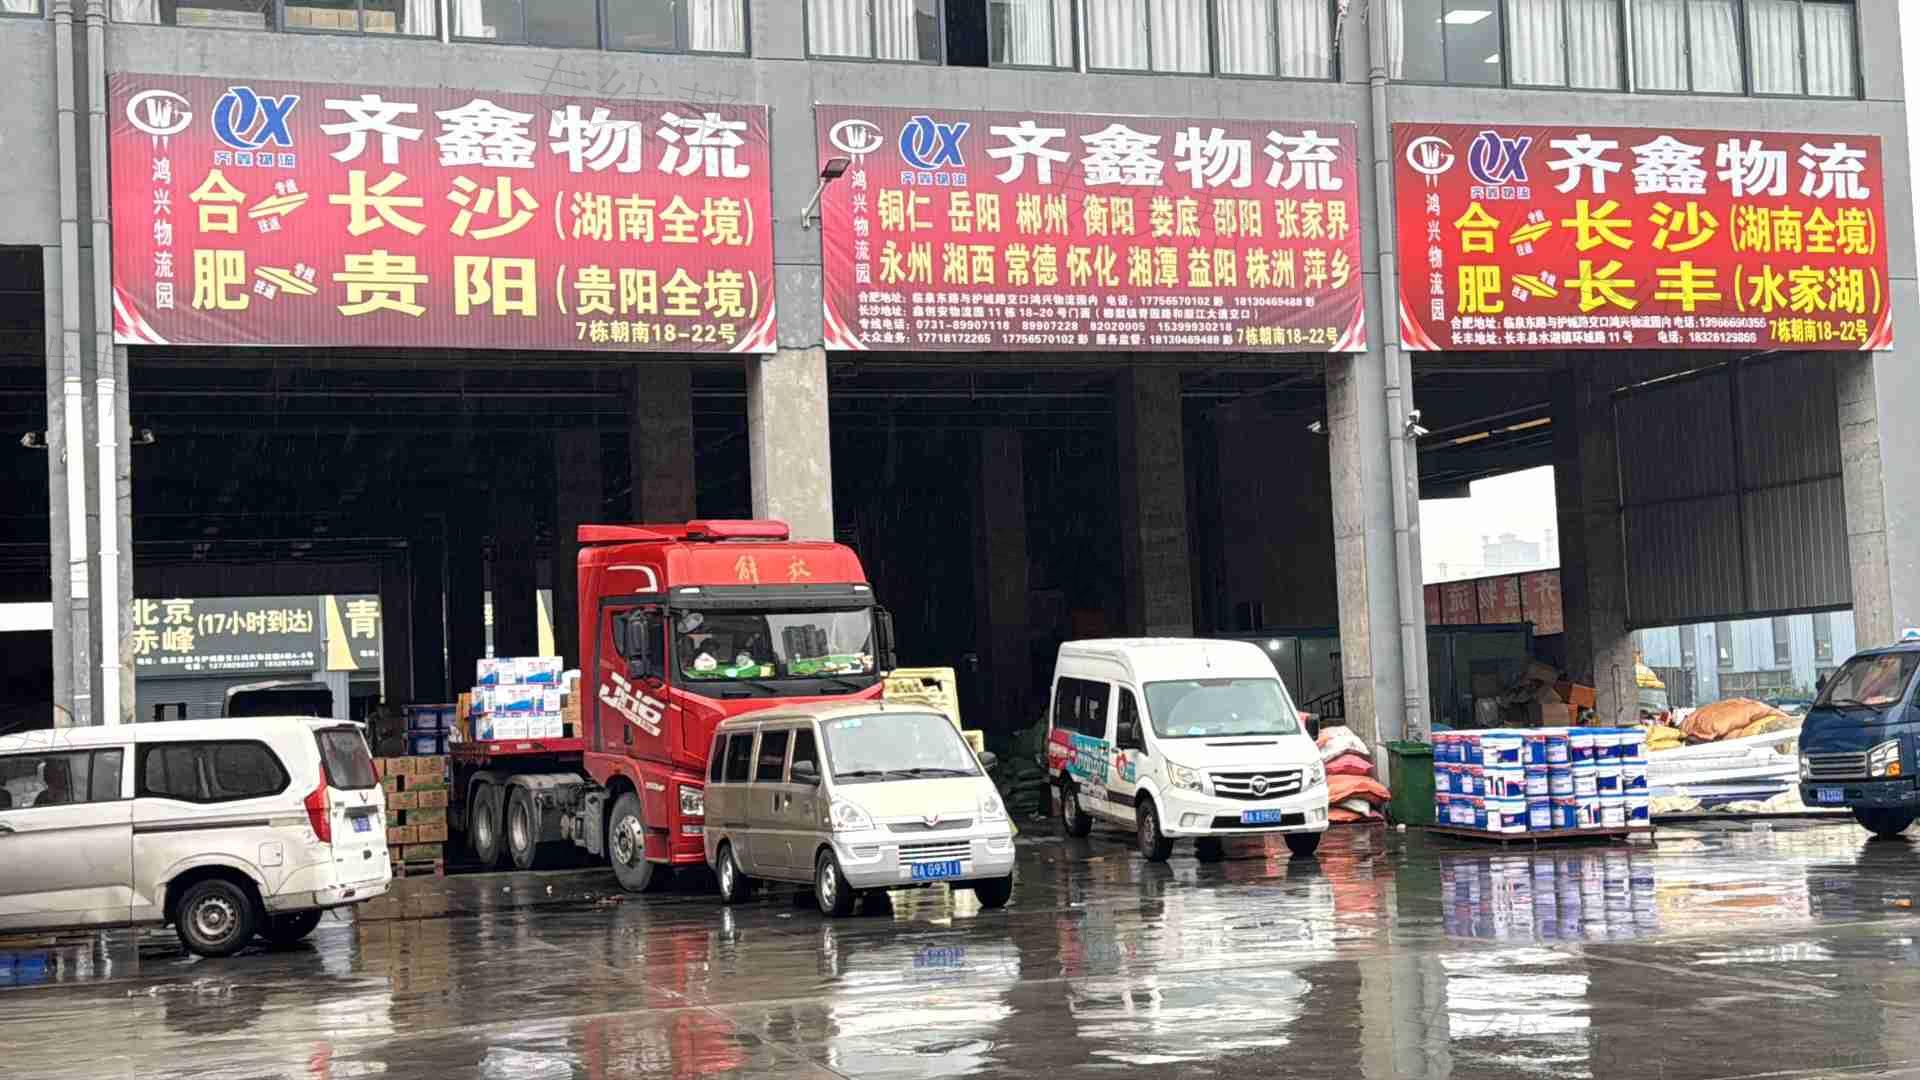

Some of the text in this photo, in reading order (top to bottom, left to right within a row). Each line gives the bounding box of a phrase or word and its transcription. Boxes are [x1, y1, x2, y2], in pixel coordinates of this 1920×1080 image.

[320, 94, 750, 178] 齐鑫物流
[986, 120, 1343, 190] 齐鑫物流
[1546, 134, 1870, 200] 齐鑫物流
[152, 158, 175, 310] 鸿兴物流园
[329, 170, 539, 240] 长沙
[851, 169, 872, 284] 鸿兴物流园
[878, 189, 1349, 240] 铜仁 岳阳 郴州 衡阳 娄底 邵阳 张家界
[1561, 200, 1719, 252] 长沙
[332, 250, 537, 317] 贵阳
[879, 240, 1351, 289] 永州 湘西 常德 怀化 湘潭 益阳 株洲 萍乡
[1426, 193, 1444, 321] 鸿兴物流园
[1564, 260, 1721, 312] 长丰
[132, 598, 194, 625] 北京
